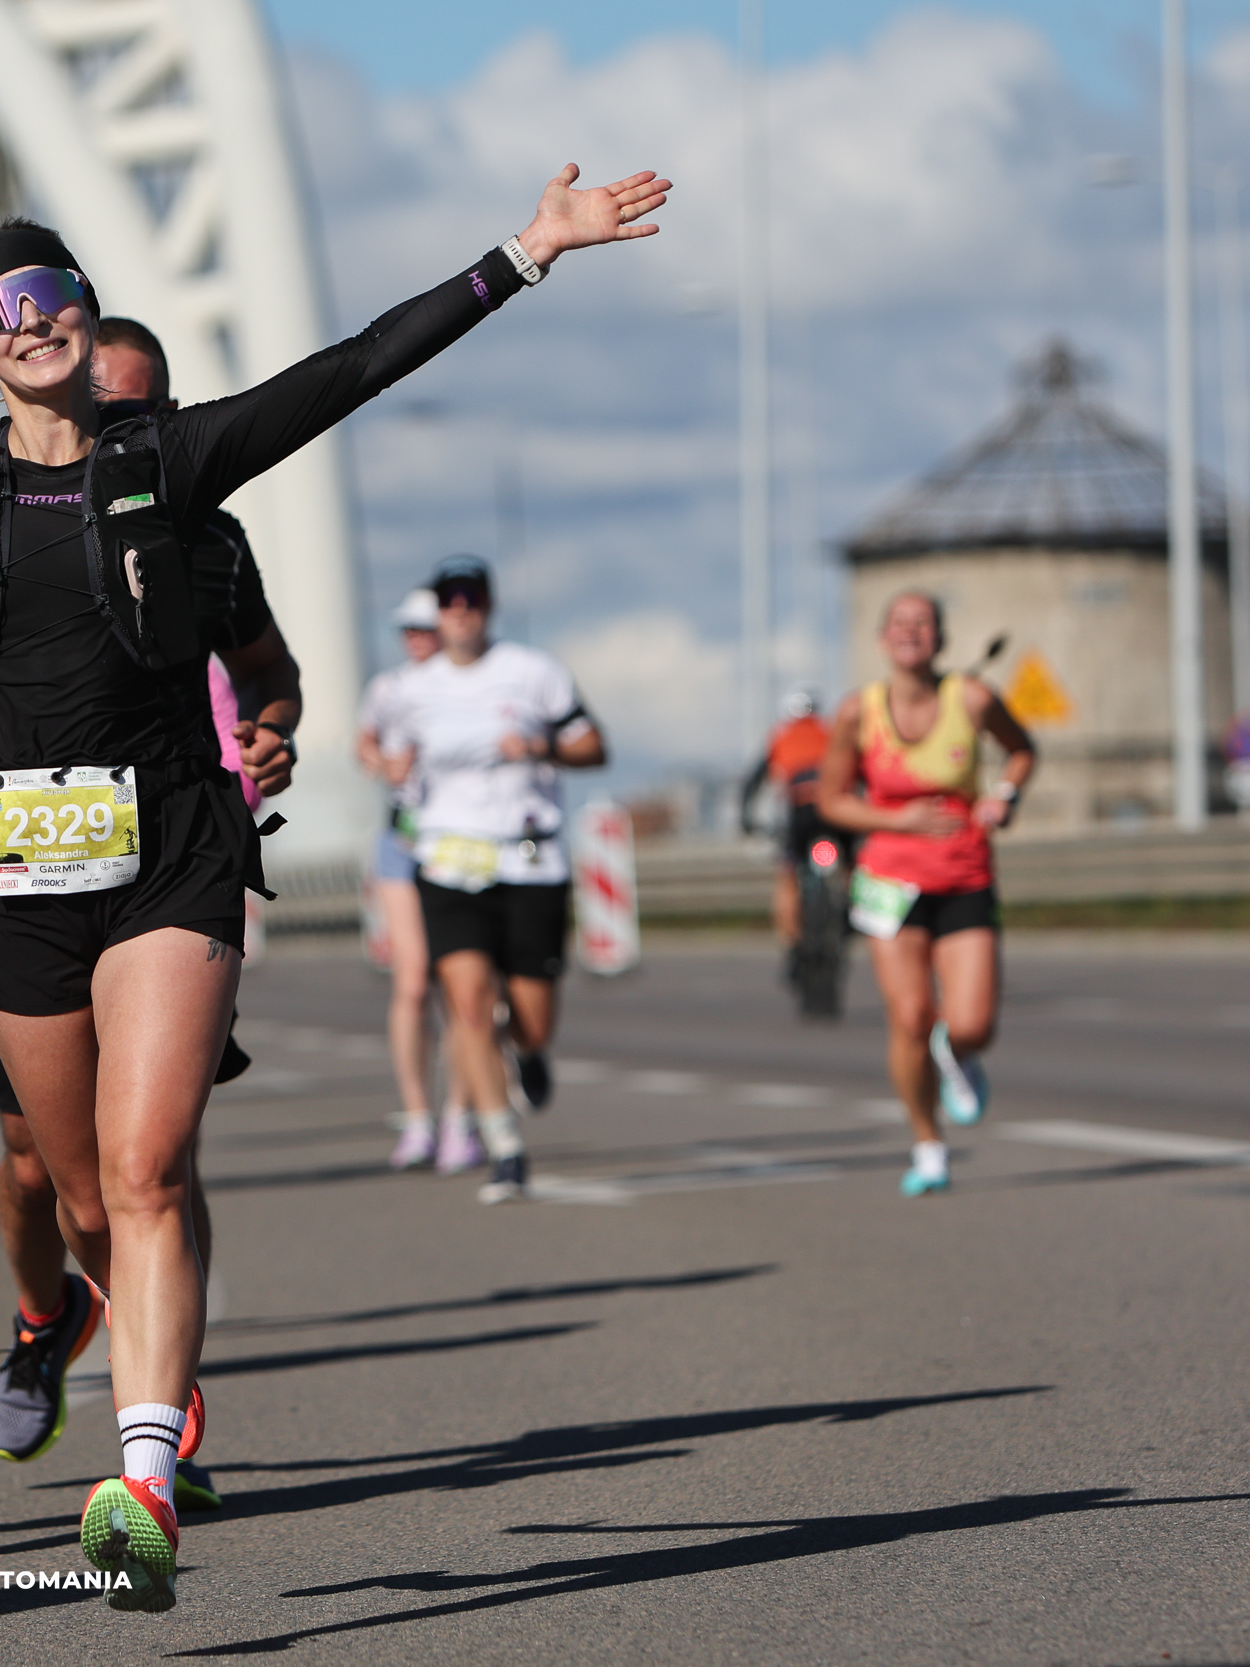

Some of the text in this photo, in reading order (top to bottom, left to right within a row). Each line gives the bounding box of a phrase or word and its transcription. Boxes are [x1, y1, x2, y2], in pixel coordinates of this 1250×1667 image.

[4, 802, 114, 847] 2329
[34, 849, 89, 860] Aleksandra
[39, 863, 85, 874] GARMIN
[31, 879, 67, 887] BROOKS
